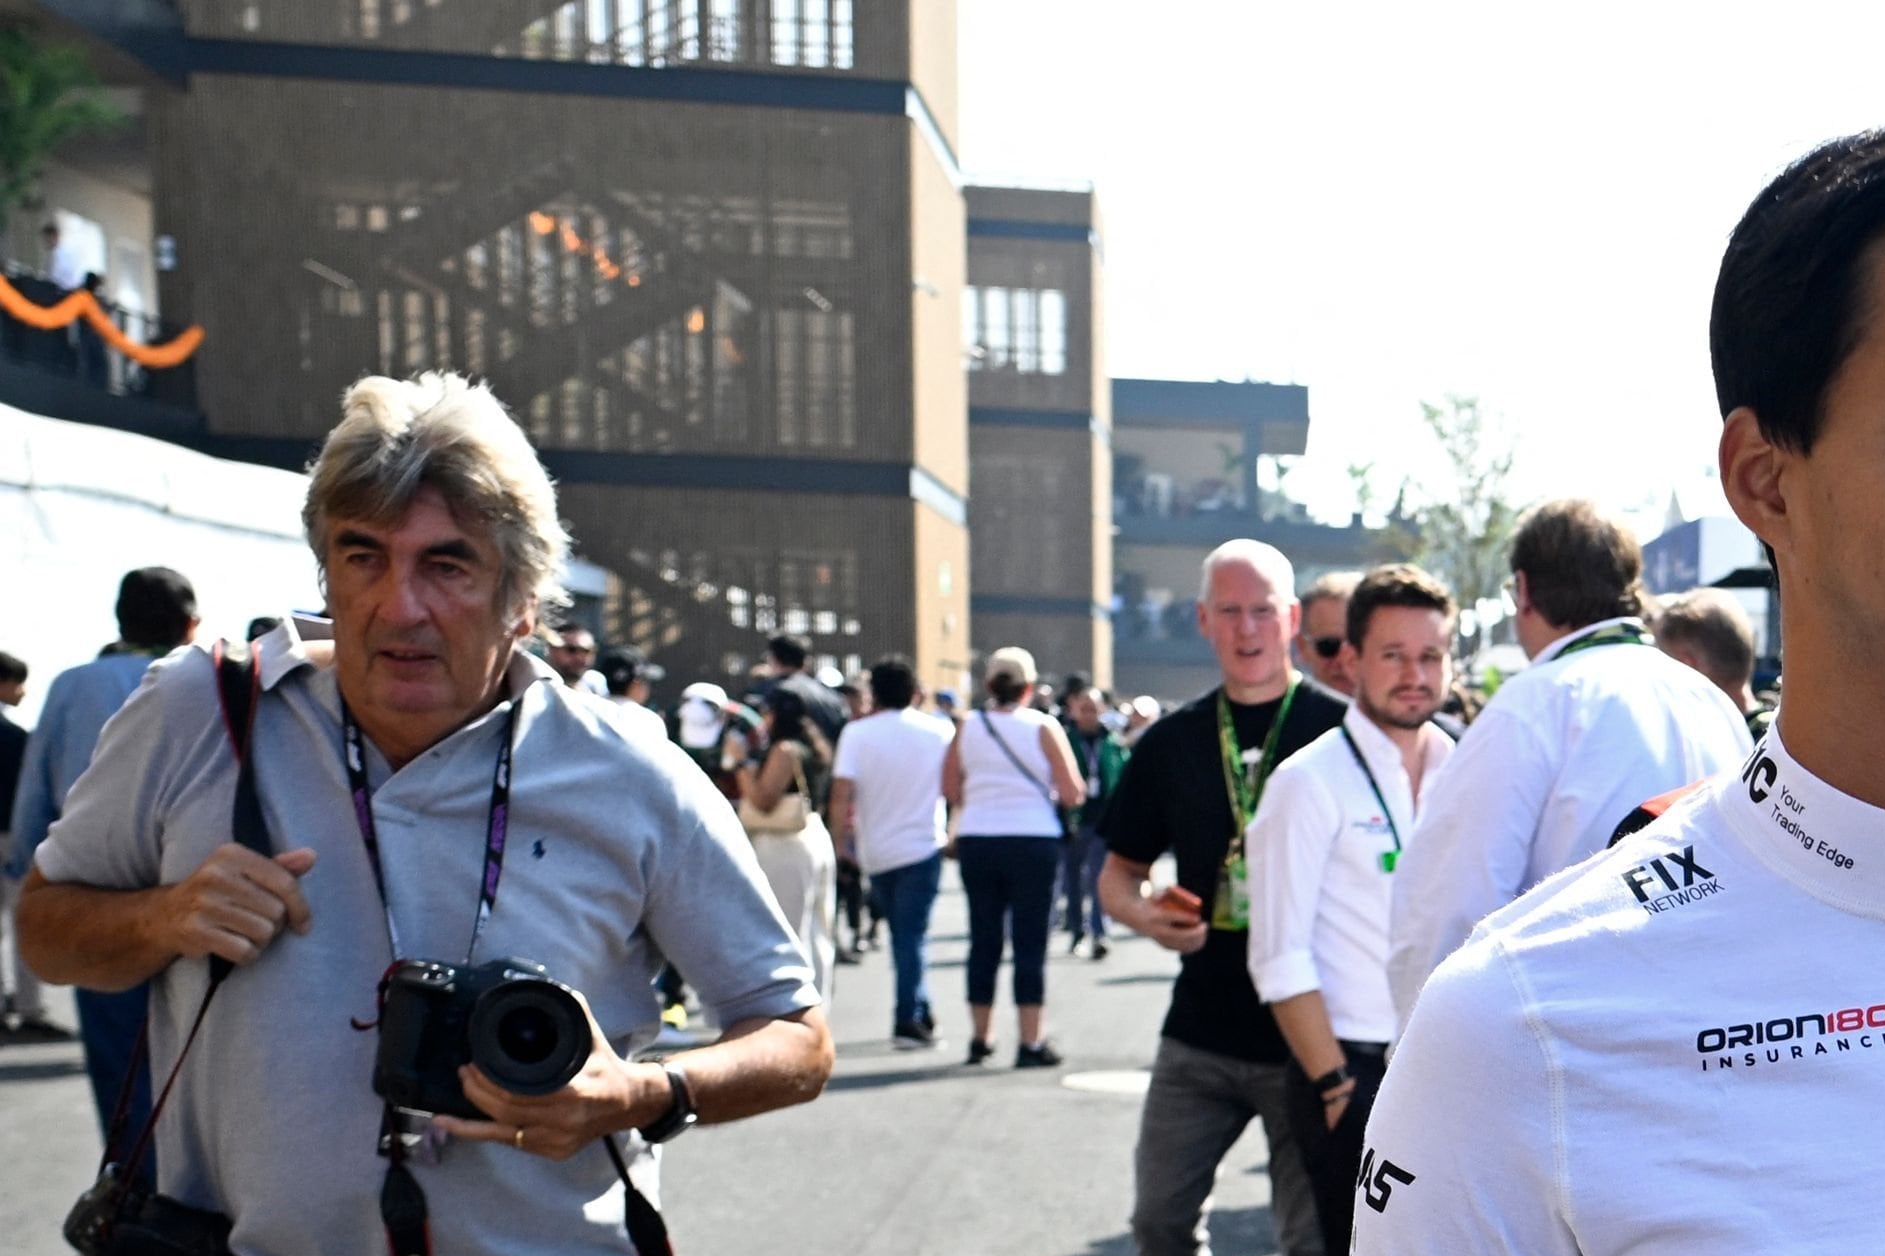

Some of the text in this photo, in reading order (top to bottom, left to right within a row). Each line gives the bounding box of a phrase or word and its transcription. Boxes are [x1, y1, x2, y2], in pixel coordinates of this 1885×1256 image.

[1780, 785, 1806, 815] Your
[1770, 804, 1855, 870] Trading Edge
[1621, 844, 1715, 904] FIX
[1643, 878, 1725, 915] NETWORK
